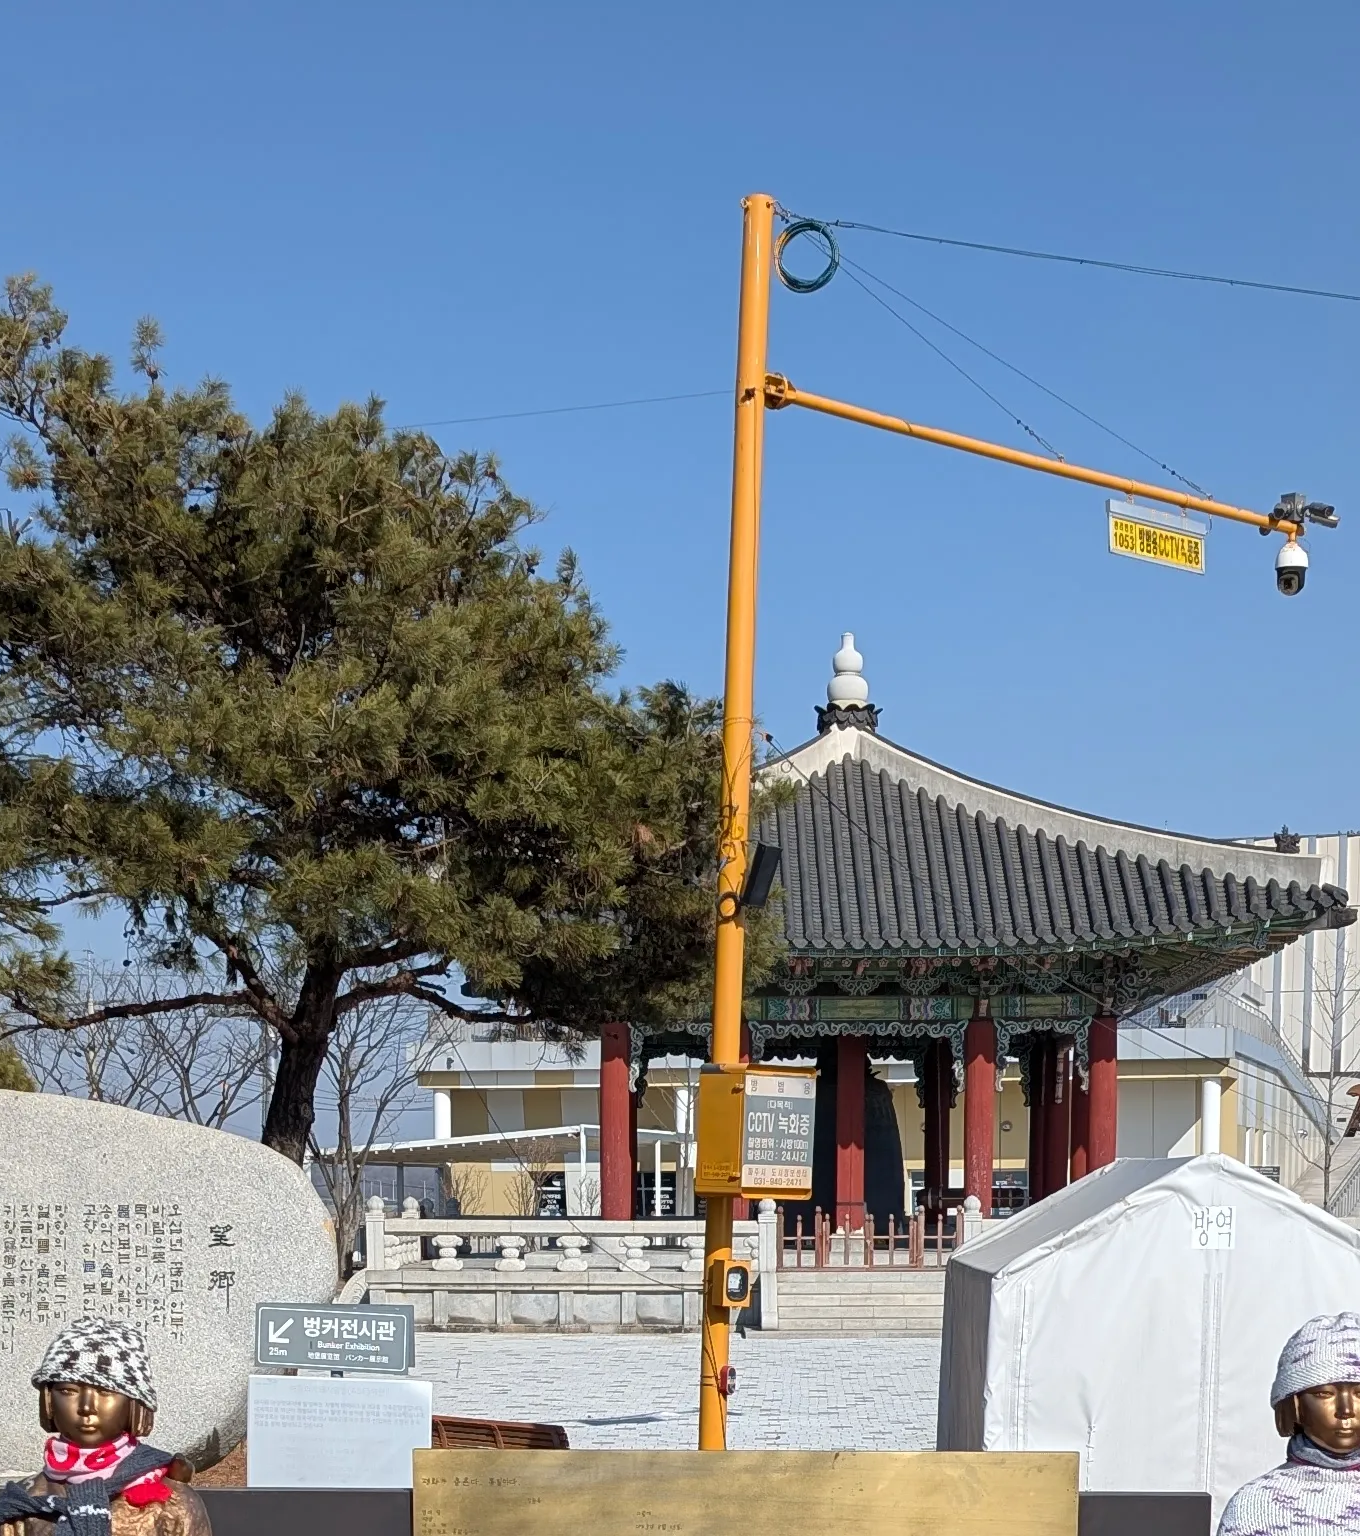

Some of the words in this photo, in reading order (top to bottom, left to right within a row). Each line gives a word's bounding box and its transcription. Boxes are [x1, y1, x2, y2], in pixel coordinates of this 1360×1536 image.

[1114, 532, 1135, 550] 1053
[747, 1112, 775, 1133] CCTV
[778, 1113, 810, 1135] 녹화중
[54, 1203, 69, 1251] 망향의
[83, 1203, 98, 1235] 고향
[100, 1203, 114, 1254] 송악산
[134, 1203, 148, 1236] 목이
[152, 1204, 166, 1264] 바람으로
[168, 1203, 183, 1252] 오십년
[1193, 1207, 1234, 1249] 방역
[19, 1258, 33, 1322] 산하에서
[117, 1274, 131, 1319] 사람아
[152, 1273, 166, 1288] 서
[152, 1298, 167, 1328] 있다
[170, 1300, 184, 1344] 안부가
[303, 1316, 397, 1342] 벙커전시관
[268, 1347, 288, 1357] 25m
[317, 1340, 344, 1351] Bunker
[345, 1342, 380, 1352] Exhibition
